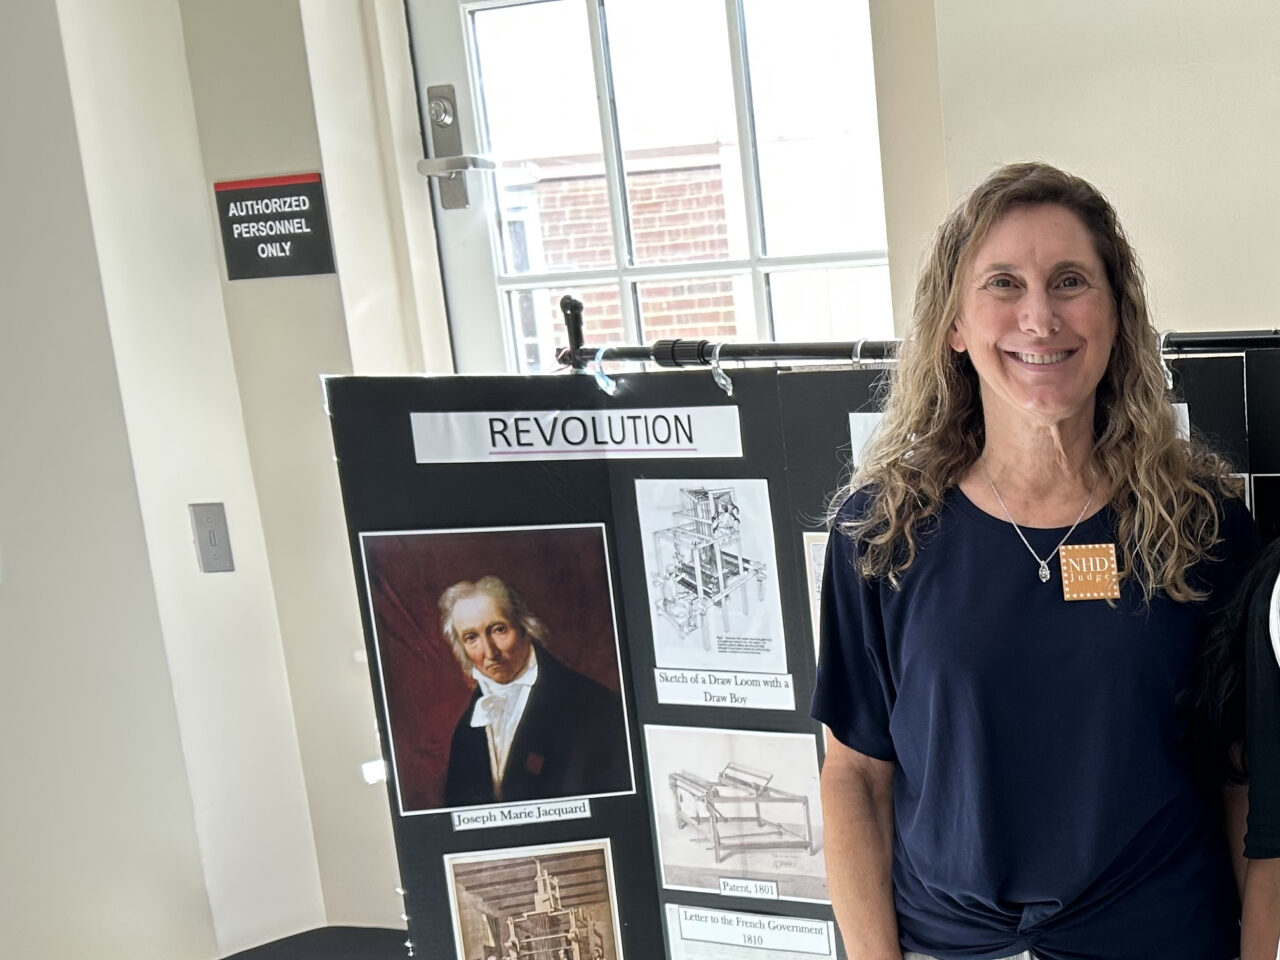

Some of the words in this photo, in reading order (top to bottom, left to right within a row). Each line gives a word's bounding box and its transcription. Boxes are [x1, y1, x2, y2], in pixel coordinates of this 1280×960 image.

[228, 195, 310, 217] AUTHORIZED
[232, 218, 311, 238] PERSONNEL
[257, 241, 291, 258] ONLY
[488, 414, 694, 448] REVOLUTION
[1068, 556, 1109, 573] NHD
[1070, 572, 1111, 583] Judge
[659, 672, 688, 684] Sketch
[690, 673, 699, 684] of
[708, 674, 732, 685] Draw
[734, 675, 761, 687] Loom
[762, 677, 781, 688] with
[704, 691, 727, 702] Draw
[729, 692, 747, 705] Boy
[455, 811, 496, 827] Joseph
[500, 808, 534, 820] Marie
[535, 802, 586, 819] Jacquard
[722, 881, 752, 894] Patent,
[755, 884, 774, 895] 1801
[684, 911, 711, 921] Letter
[711, 913, 719, 923] to
[721, 915, 733, 926] the
[736, 917, 765, 930] French
[768, 920, 824, 935] Government
[742, 934, 763, 945] 1810
